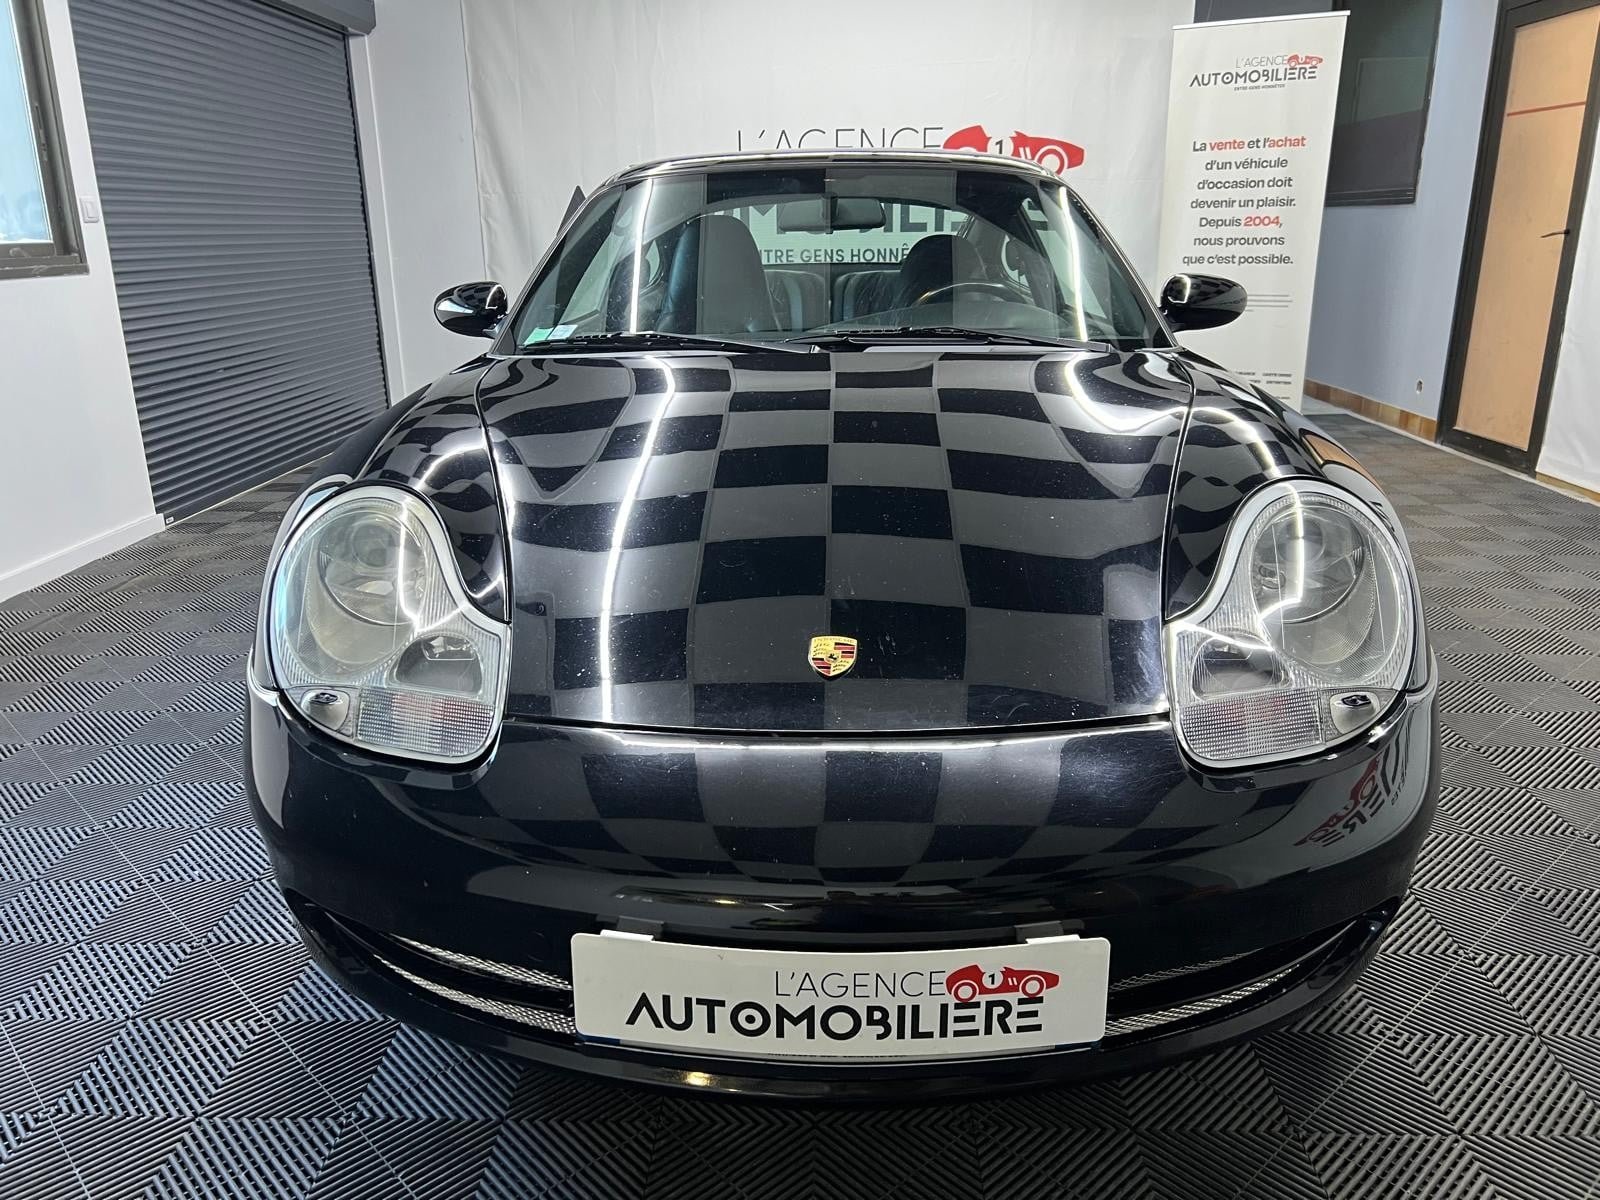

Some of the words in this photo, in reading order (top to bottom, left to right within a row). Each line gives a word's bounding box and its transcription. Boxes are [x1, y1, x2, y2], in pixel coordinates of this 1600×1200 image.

[1235, 55, 1288, 68] L'AGENCE
[1193, 140, 1207, 152] La
[1209, 138, 1245, 151] vente
[1247, 138, 1261, 149] et
[1263, 136, 1306, 149] l'achat
[1205, 159, 1232, 170] d'un
[1234, 157, 1288, 170] véhicule
[1197, 178, 1265, 190] d'occasion
[1267, 177, 1293, 188] doit
[1190, 197, 1237, 209] devenir
[1238, 199, 1254, 208] un
[1256, 196, 1297, 209] plaisir.
[1199, 217, 1242, 229] Depuis
[1243, 215, 1283, 228] 2004,
[1193, 236, 1224, 246] nous
[1225, 236, 1285, 247] prouvons
[759, 249, 794, 263] TRE
[800, 248, 844, 263] GENS
[850, 242, 910, 263] HONNÊ
[1182, 256, 1205, 266] que
[1207, 254, 1236, 264] c'est
[1238, 253, 1294, 266] possible.
[775, 970, 946, 998] L'AGENCE
